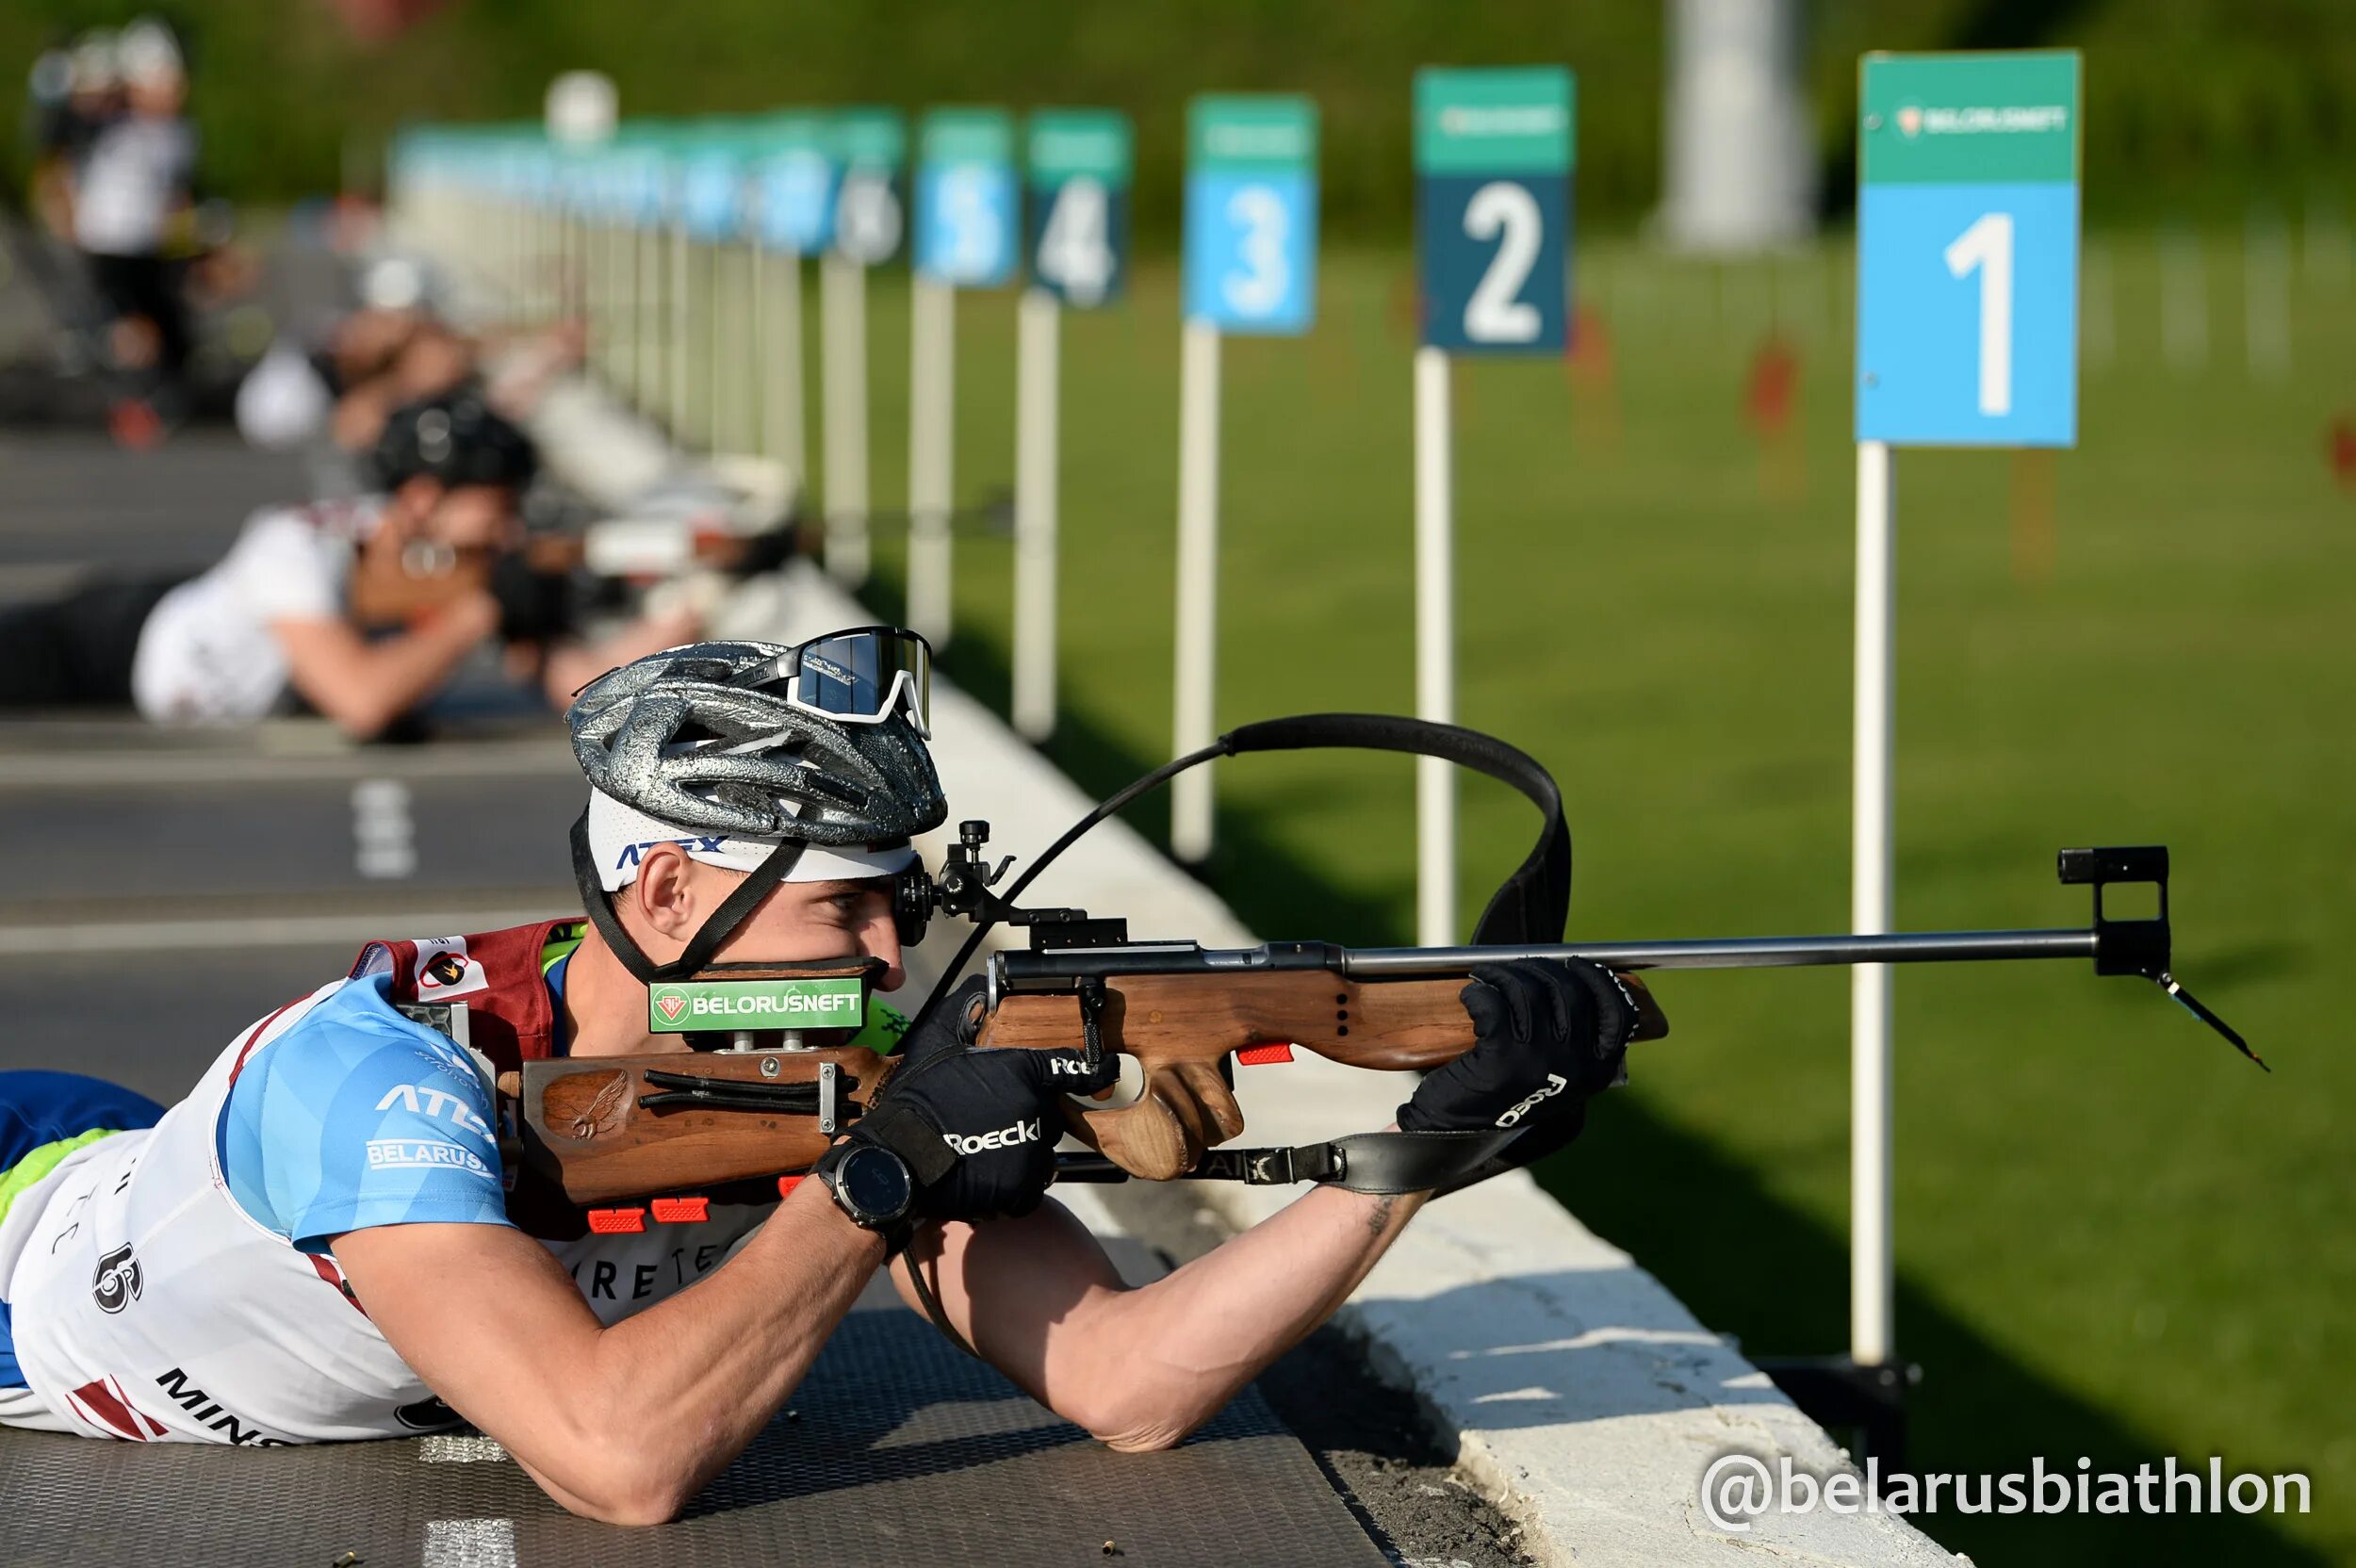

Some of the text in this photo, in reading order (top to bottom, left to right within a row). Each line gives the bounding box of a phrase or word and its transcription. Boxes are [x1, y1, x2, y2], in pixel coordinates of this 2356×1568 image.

[1038, 175, 1115, 308] 4
[1222, 185, 1289, 317] 3
[1464, 181, 1543, 342] 2
[1945, 212, 2013, 416] 1
[693, 993, 859, 1016] BELORUSNEFT
